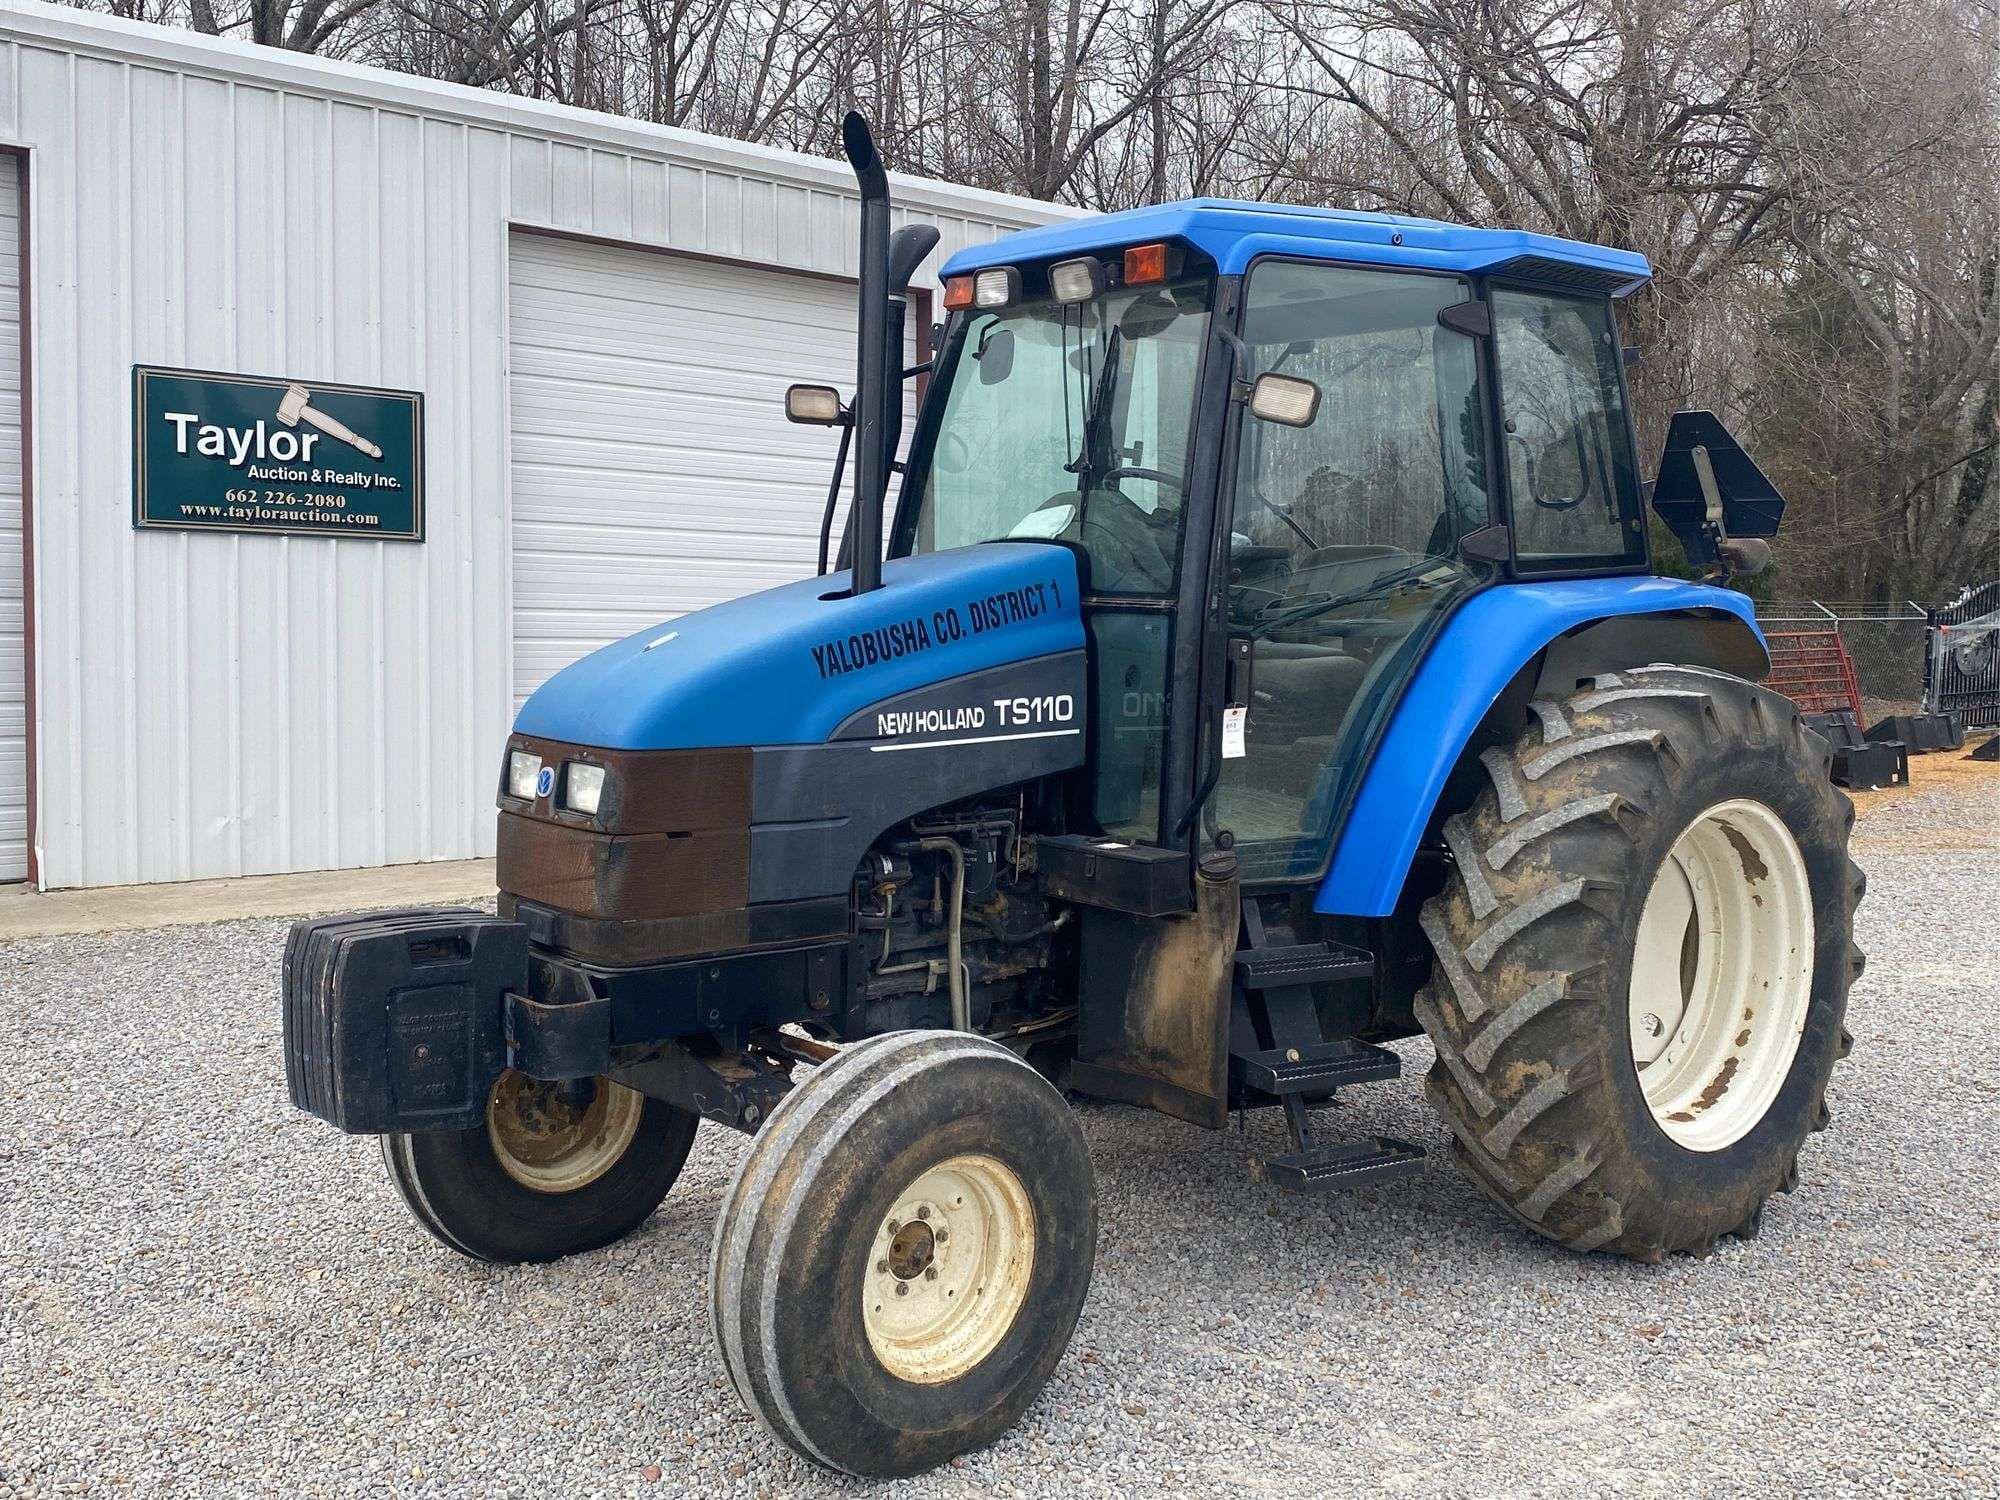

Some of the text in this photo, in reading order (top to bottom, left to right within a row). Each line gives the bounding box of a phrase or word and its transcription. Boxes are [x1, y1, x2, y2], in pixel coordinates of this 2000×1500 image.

[164, 412, 319, 466] Taylor
[248, 464, 401, 488] Auction & Realty Inc.
[225, 488, 346, 508] 662 226-2080
[180, 503, 379, 525] www.taylorauction.com
[810, 578, 1062, 680] YALOBUSHA CO. DISTRICT 1
[993, 694, 1073, 726] TS110
